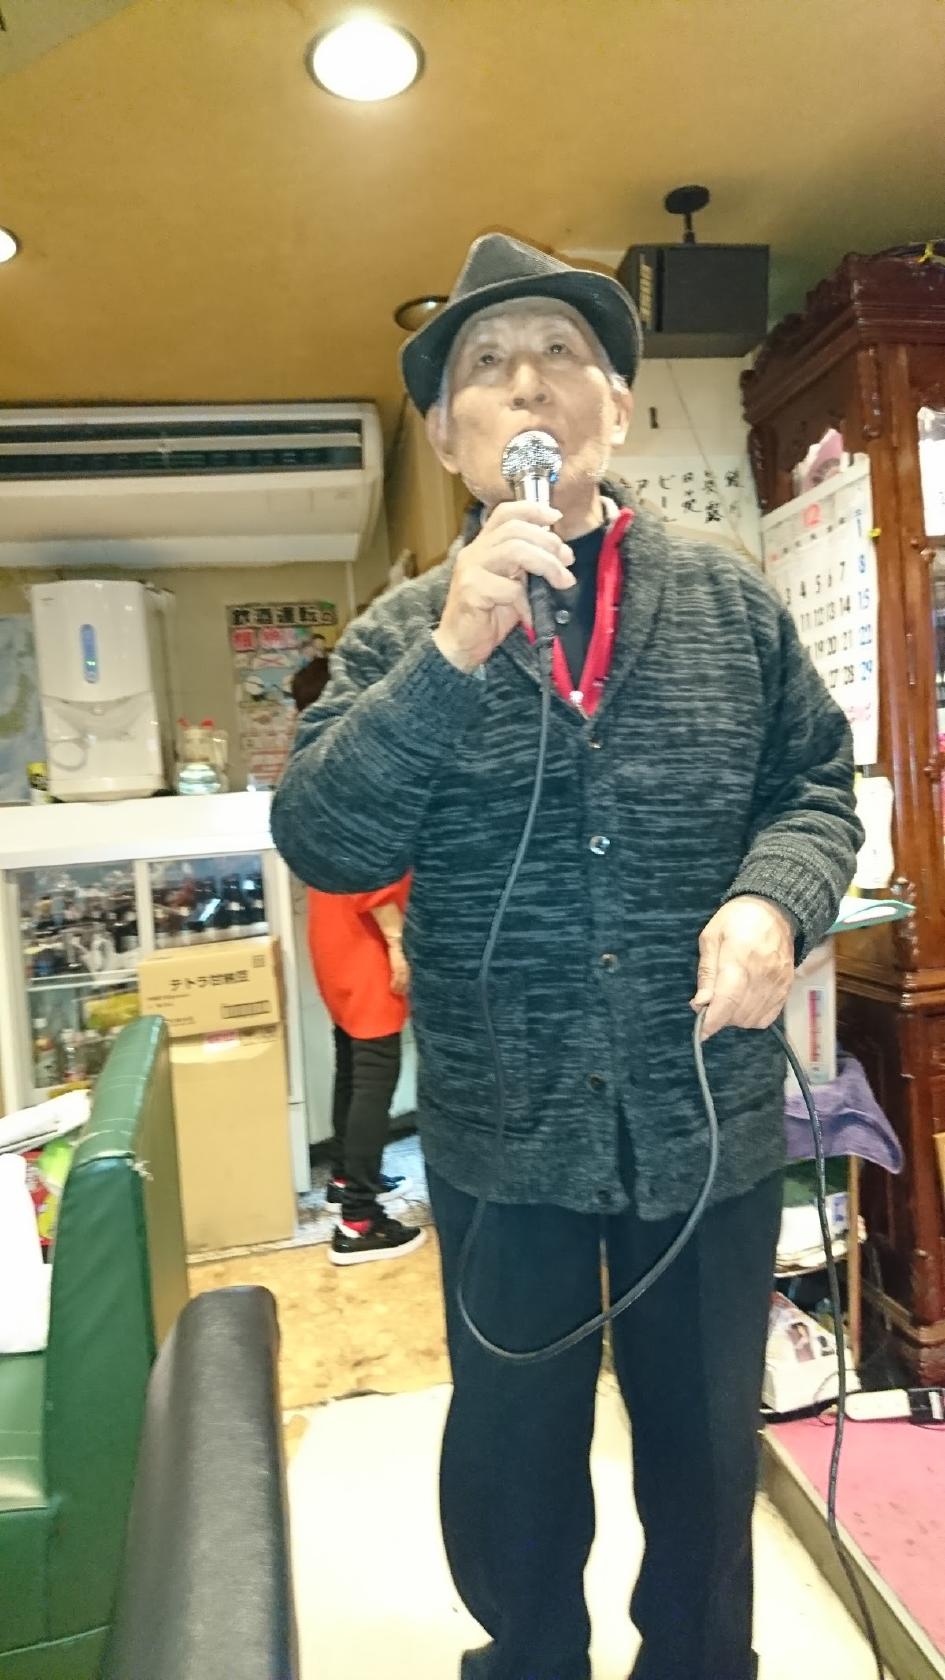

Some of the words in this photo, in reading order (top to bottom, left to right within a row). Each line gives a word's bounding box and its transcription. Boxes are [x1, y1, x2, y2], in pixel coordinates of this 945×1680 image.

[800, 580, 807, 599] 4
[815, 574, 822, 595] 5
[839, 560, 847, 582] 7
[839, 594, 852, 614] 14
[232, 606, 337, 625] 飲酒運転の
